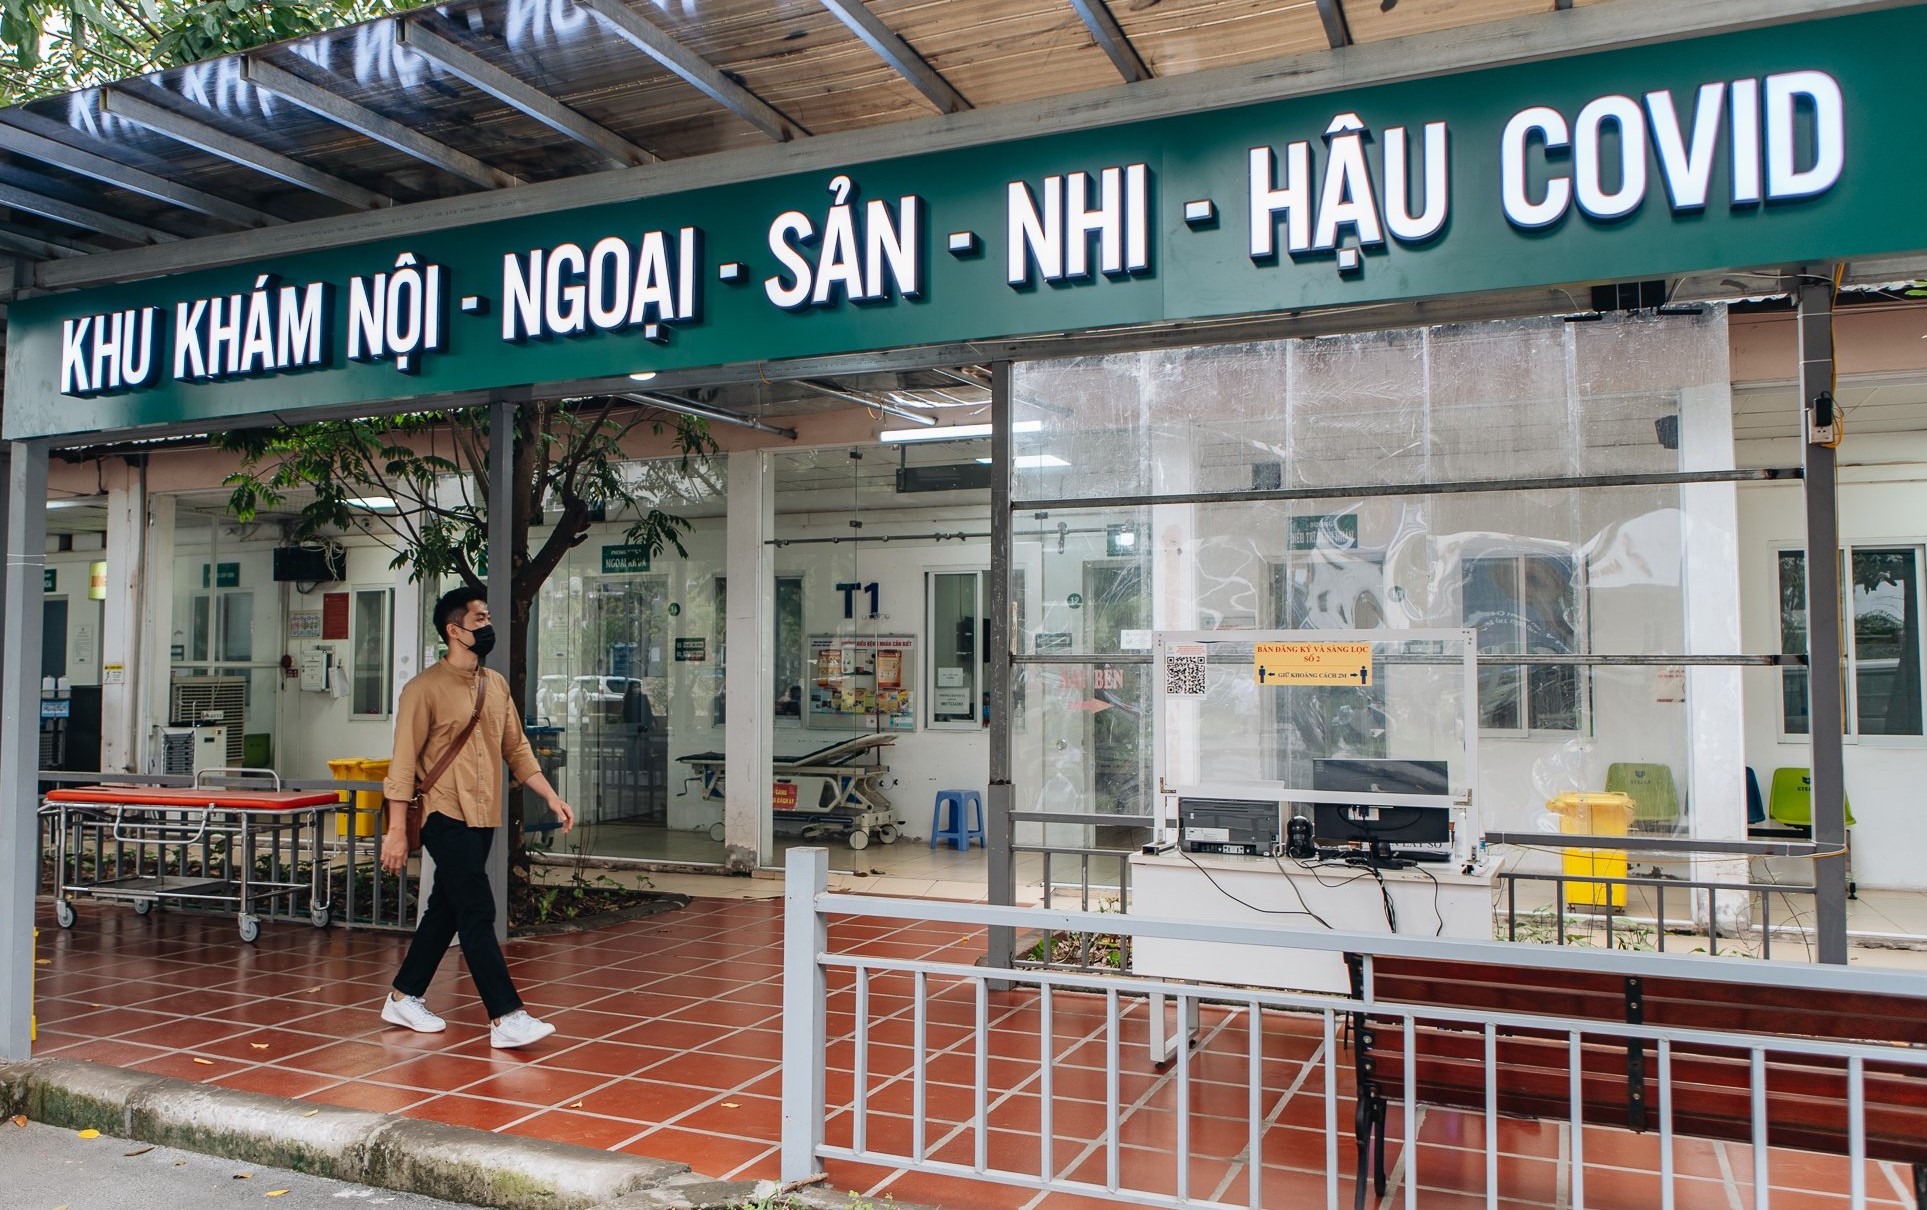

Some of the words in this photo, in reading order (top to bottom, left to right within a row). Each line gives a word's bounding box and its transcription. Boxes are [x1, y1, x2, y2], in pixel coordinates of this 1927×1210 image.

[62, 308, 156, 393] KHU
[175, 274, 325, 382] KHÁM
[348, 253, 441, 373] NỘI
[503, 227, 697, 341] NGOẠI
[765, 176, 918, 308] SẢN
[1008, 164, 1147, 284] NHI
[1250, 112, 1448, 273] HẬU
[1503, 72, 1845, 228] COVID
[835, 582, 879, 619] T1
